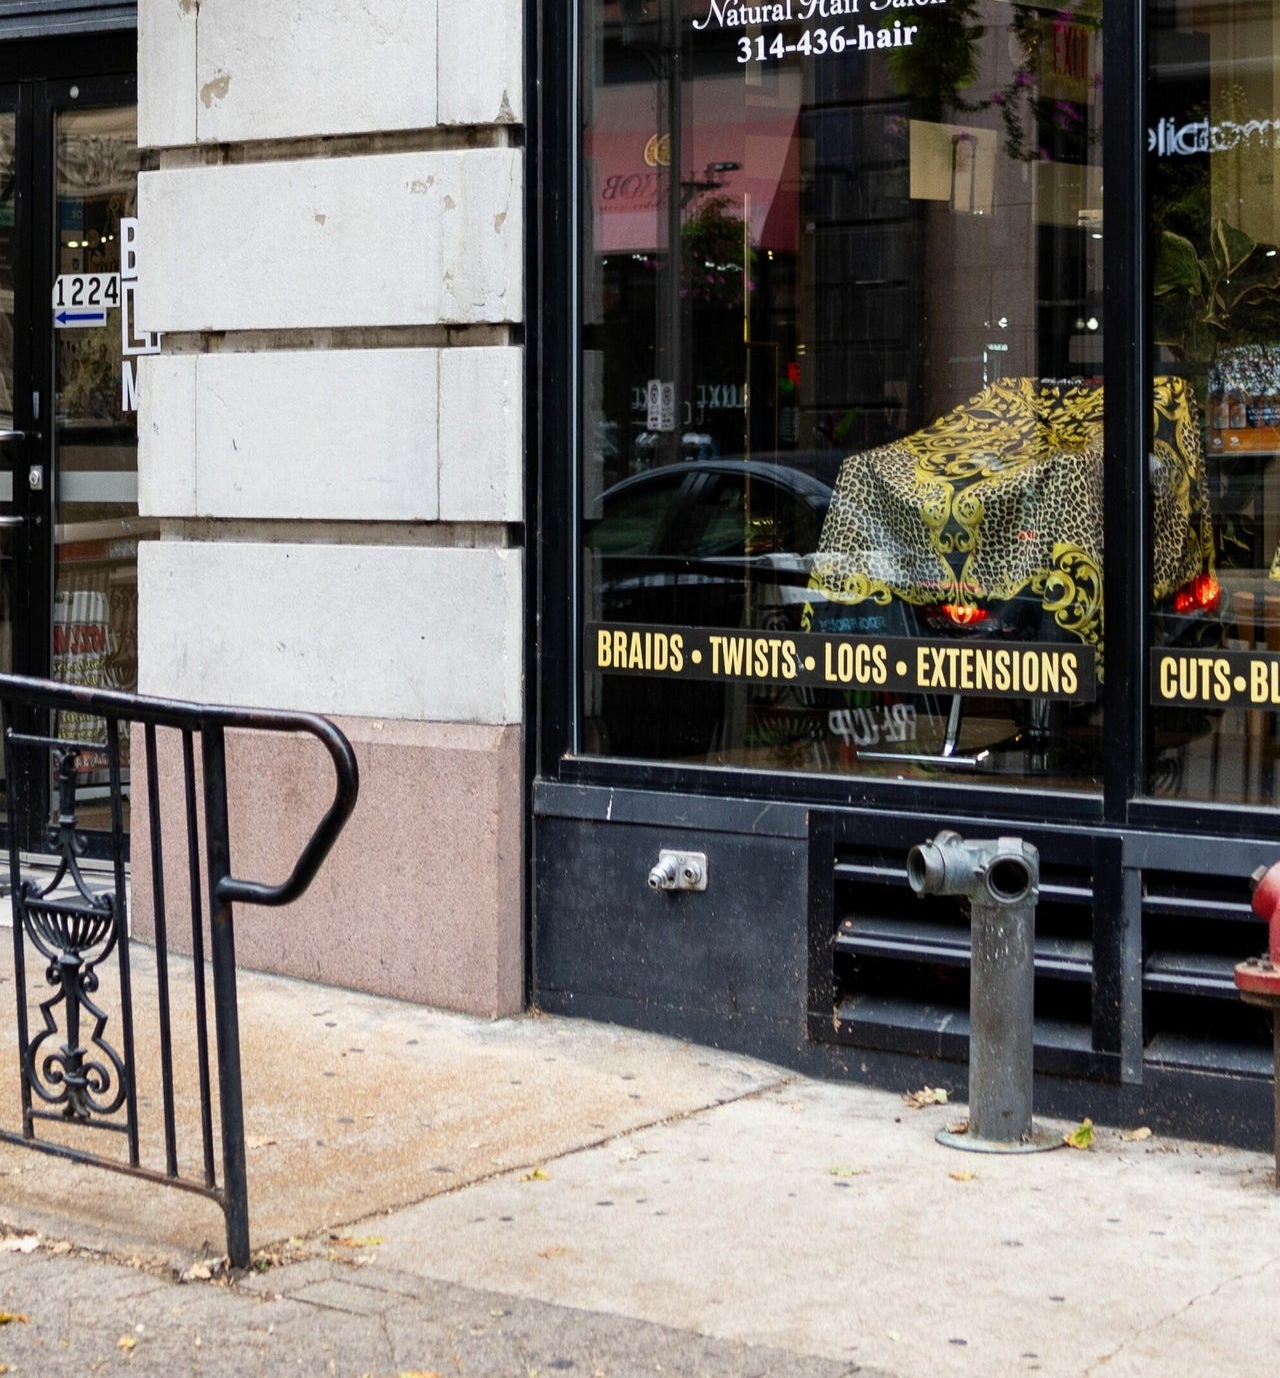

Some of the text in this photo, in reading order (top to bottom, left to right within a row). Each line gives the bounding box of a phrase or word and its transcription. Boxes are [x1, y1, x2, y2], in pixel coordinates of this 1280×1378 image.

[736, 24, 919, 64] 314-436-hair
[56, 275, 119, 307] 1224
[597, 629, 1079, 694] BRAIDS TWISTS LOCS EXTENSIONS
